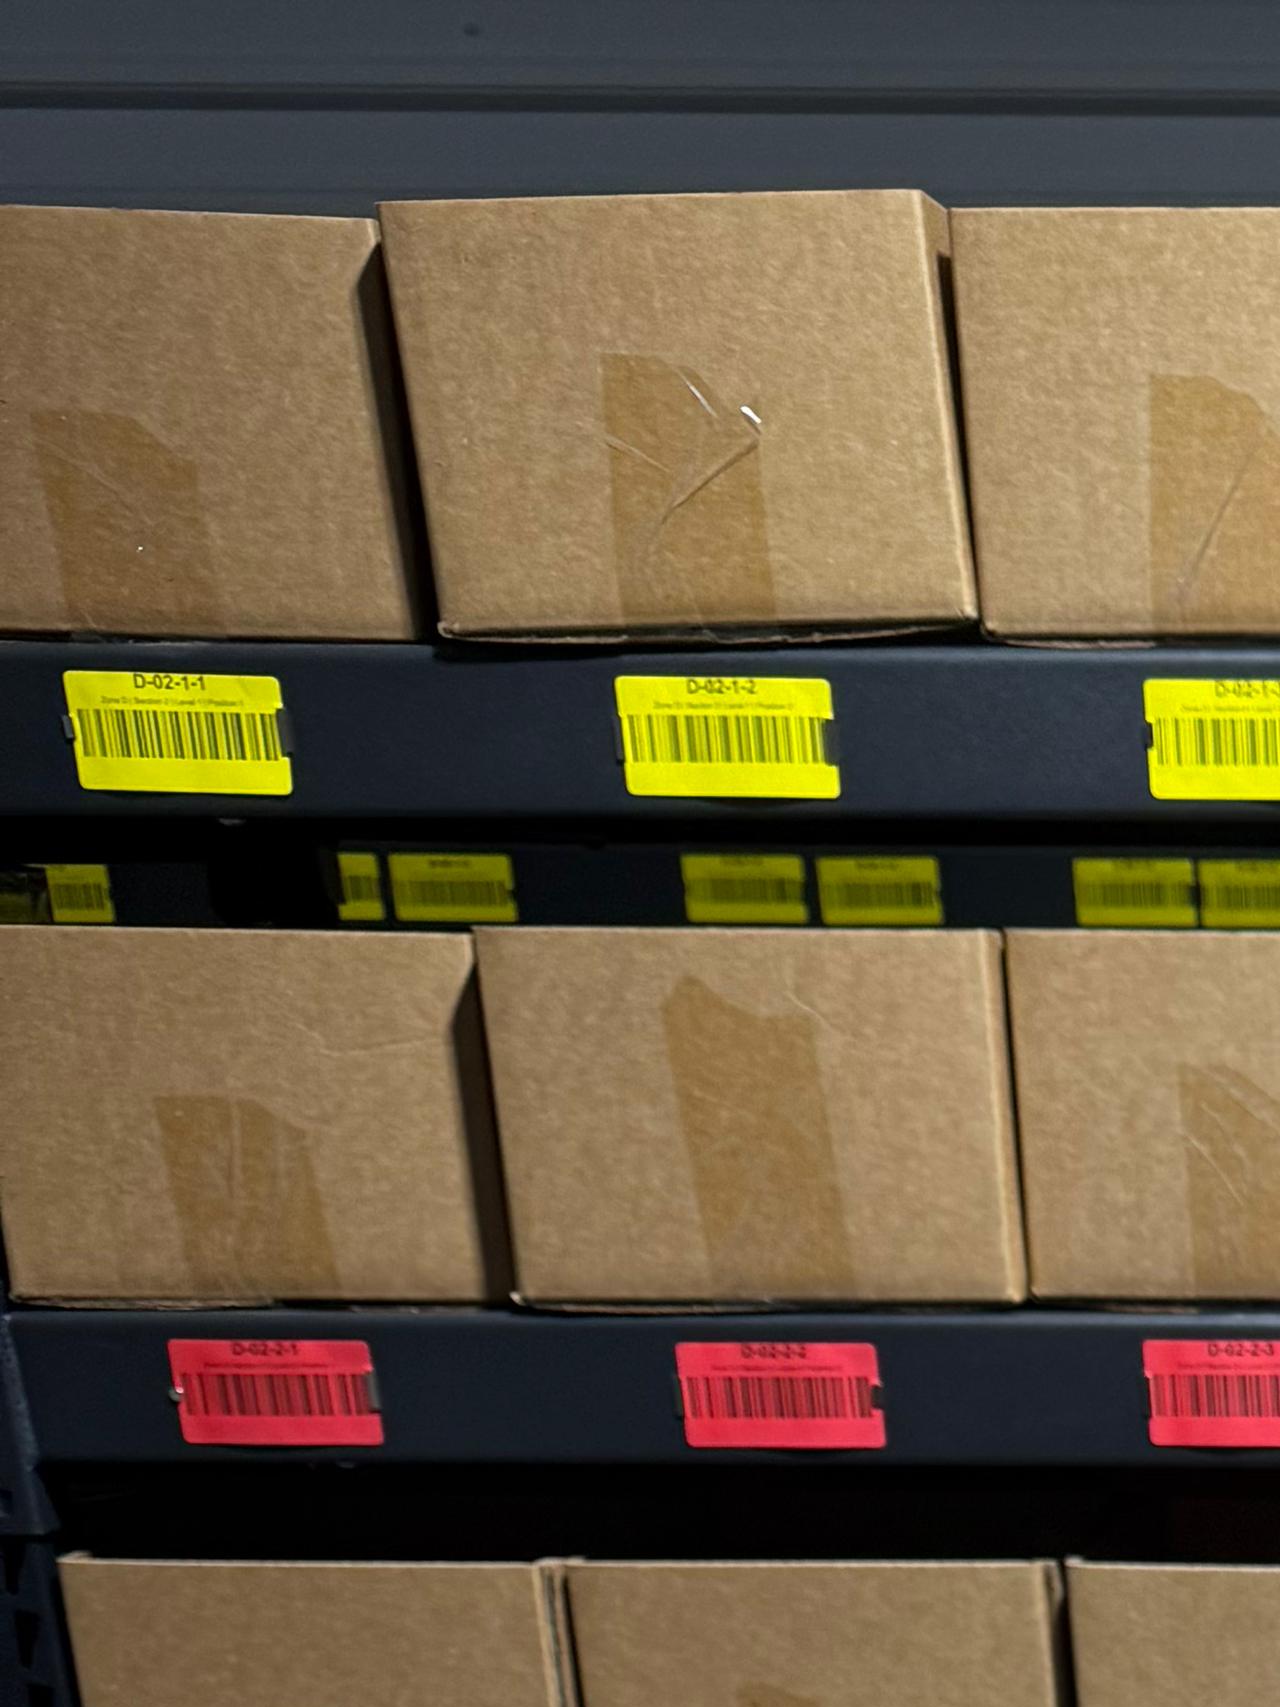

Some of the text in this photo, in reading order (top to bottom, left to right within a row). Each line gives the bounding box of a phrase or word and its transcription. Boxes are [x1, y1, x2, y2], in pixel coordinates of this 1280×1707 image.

[133, 673, 206, 691] D-02-1-1
[686, 679, 757, 695] D-02-1-2
[1207, 1342, 1274, 1358] D-02-2-3
